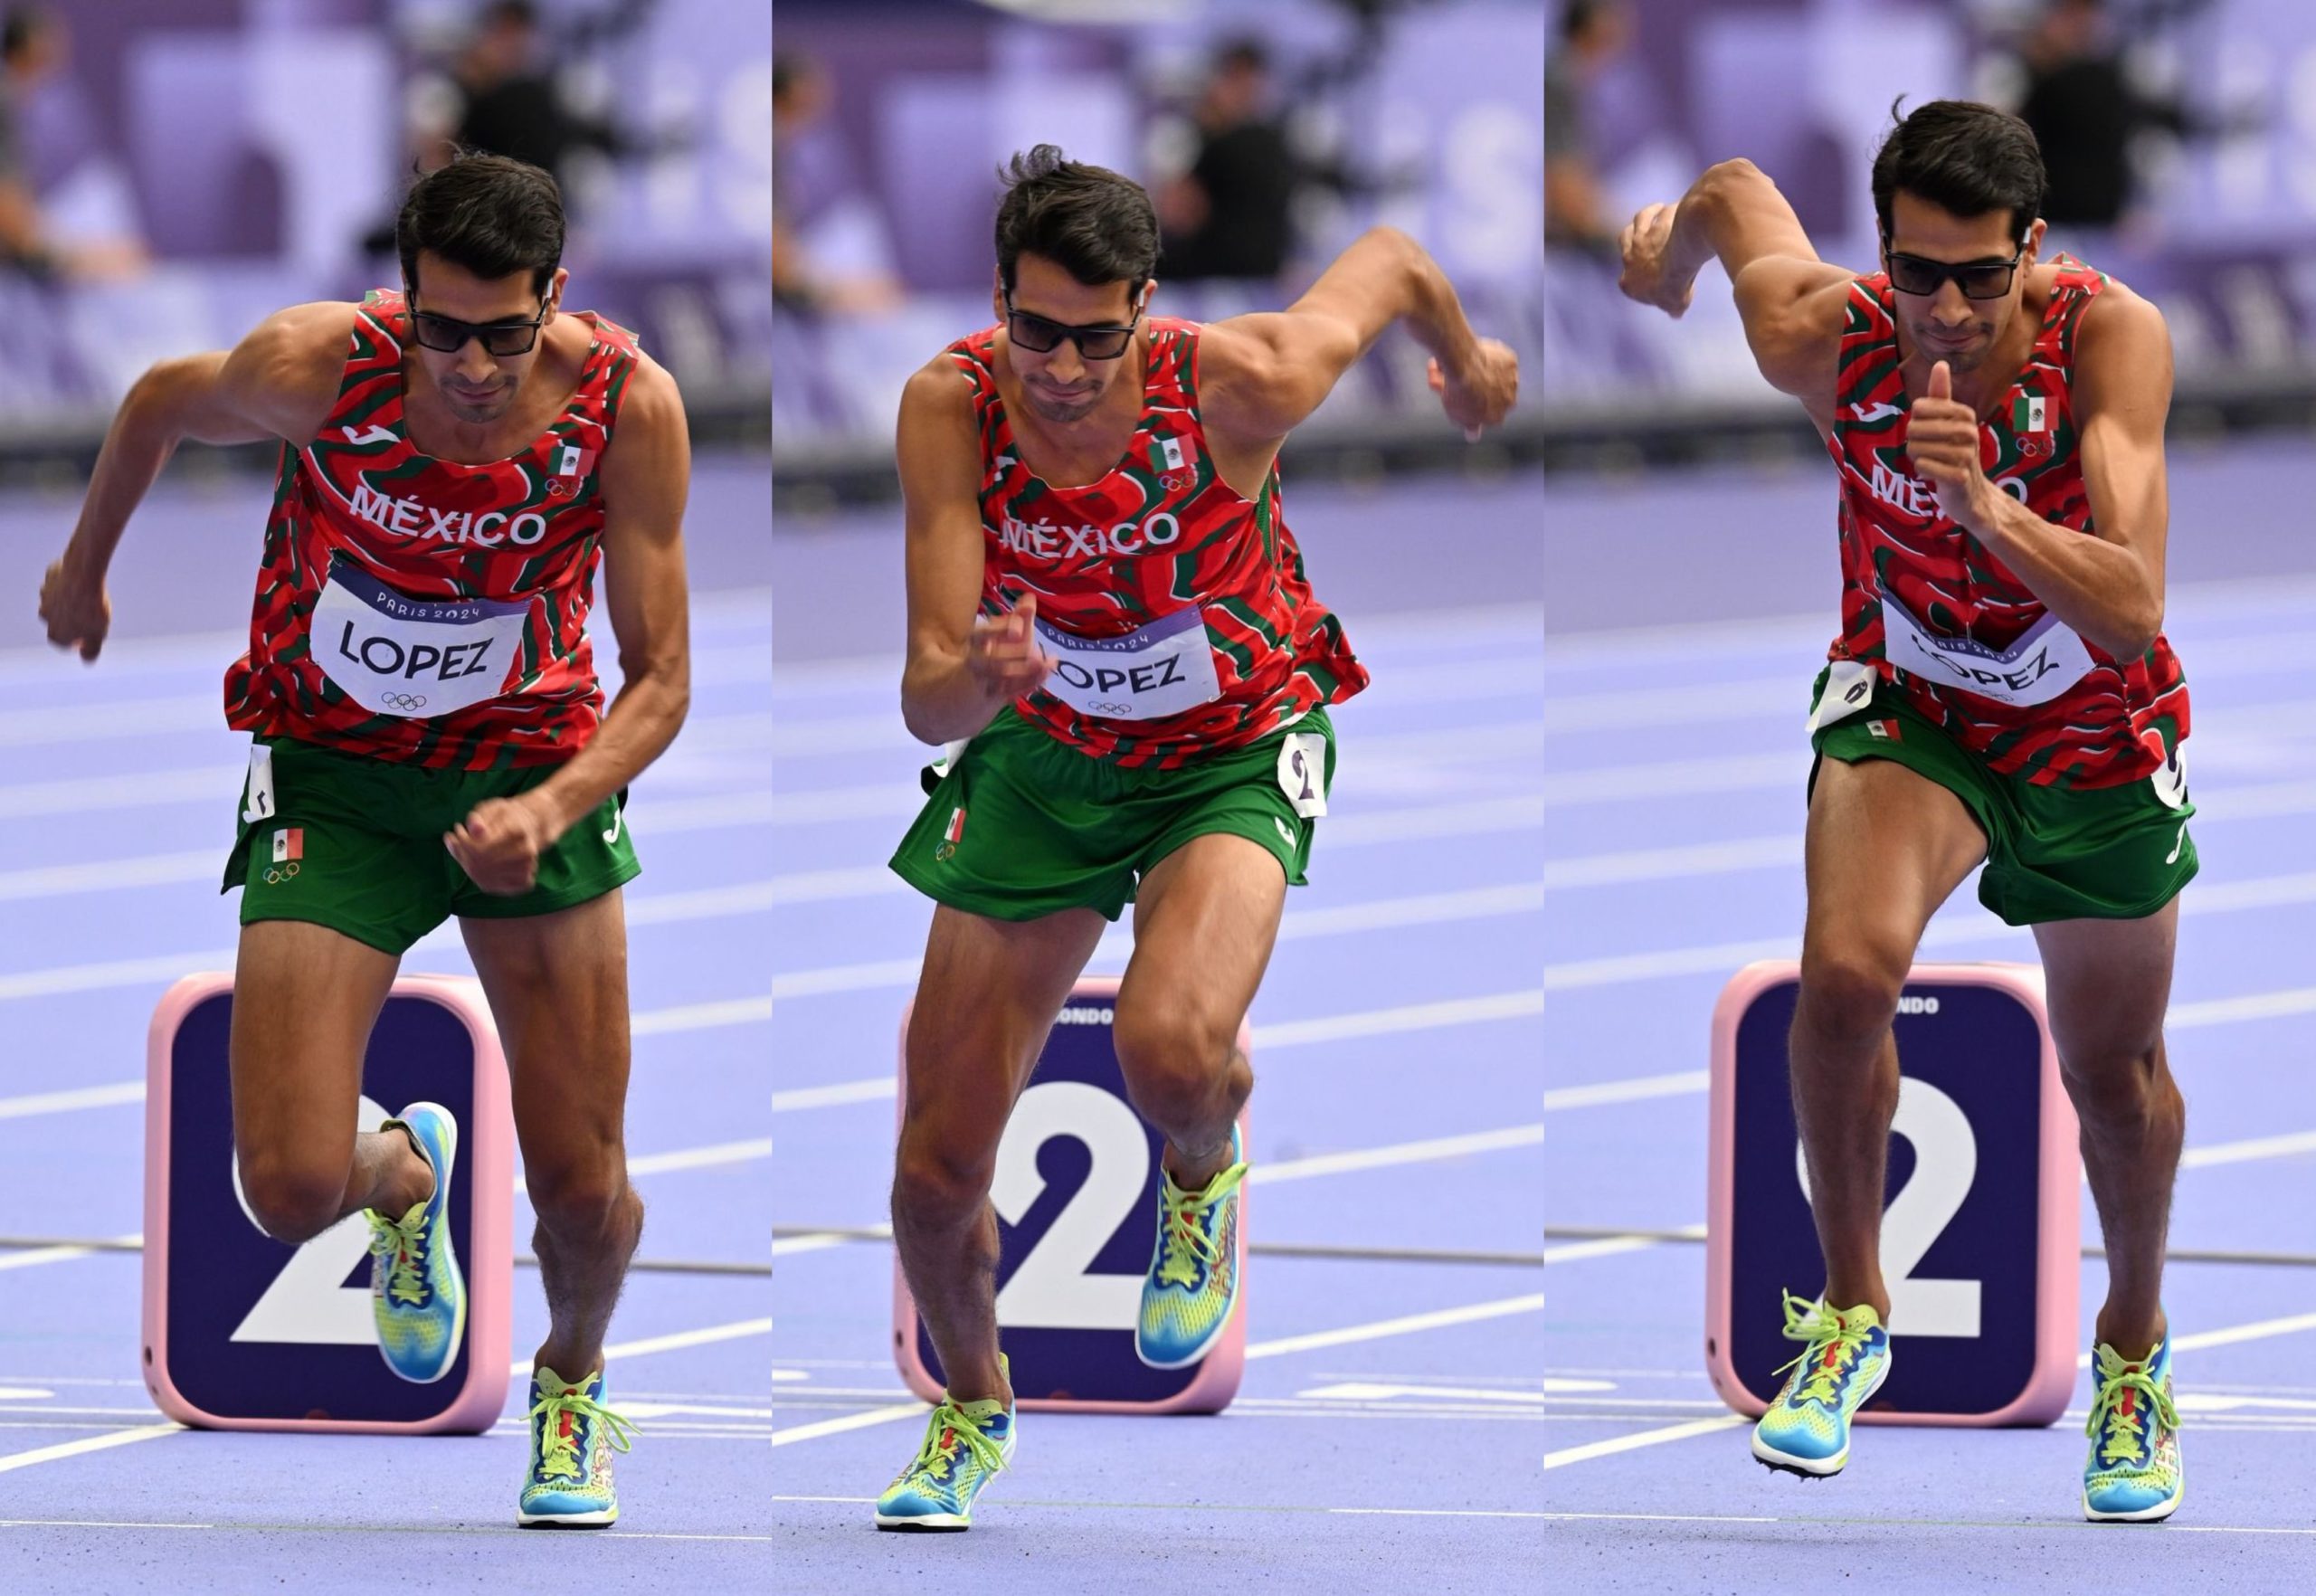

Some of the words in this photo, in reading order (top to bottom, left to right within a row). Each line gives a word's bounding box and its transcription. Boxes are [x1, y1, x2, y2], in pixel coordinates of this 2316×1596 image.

[349, 485, 546, 545] MÉXICO
[1001, 512, 1180, 558] MÉXICO
[376, 592, 427, 617] PARIS
[433, 607, 479, 620] 2024
[339, 620, 494, 680] LOPEZ
[1057, 1007, 1114, 1025] ONDO
[1896, 996, 1940, 1014] NDO
[989, 1081, 1150, 1330] 2
[1796, 1076, 1982, 1338] 2
